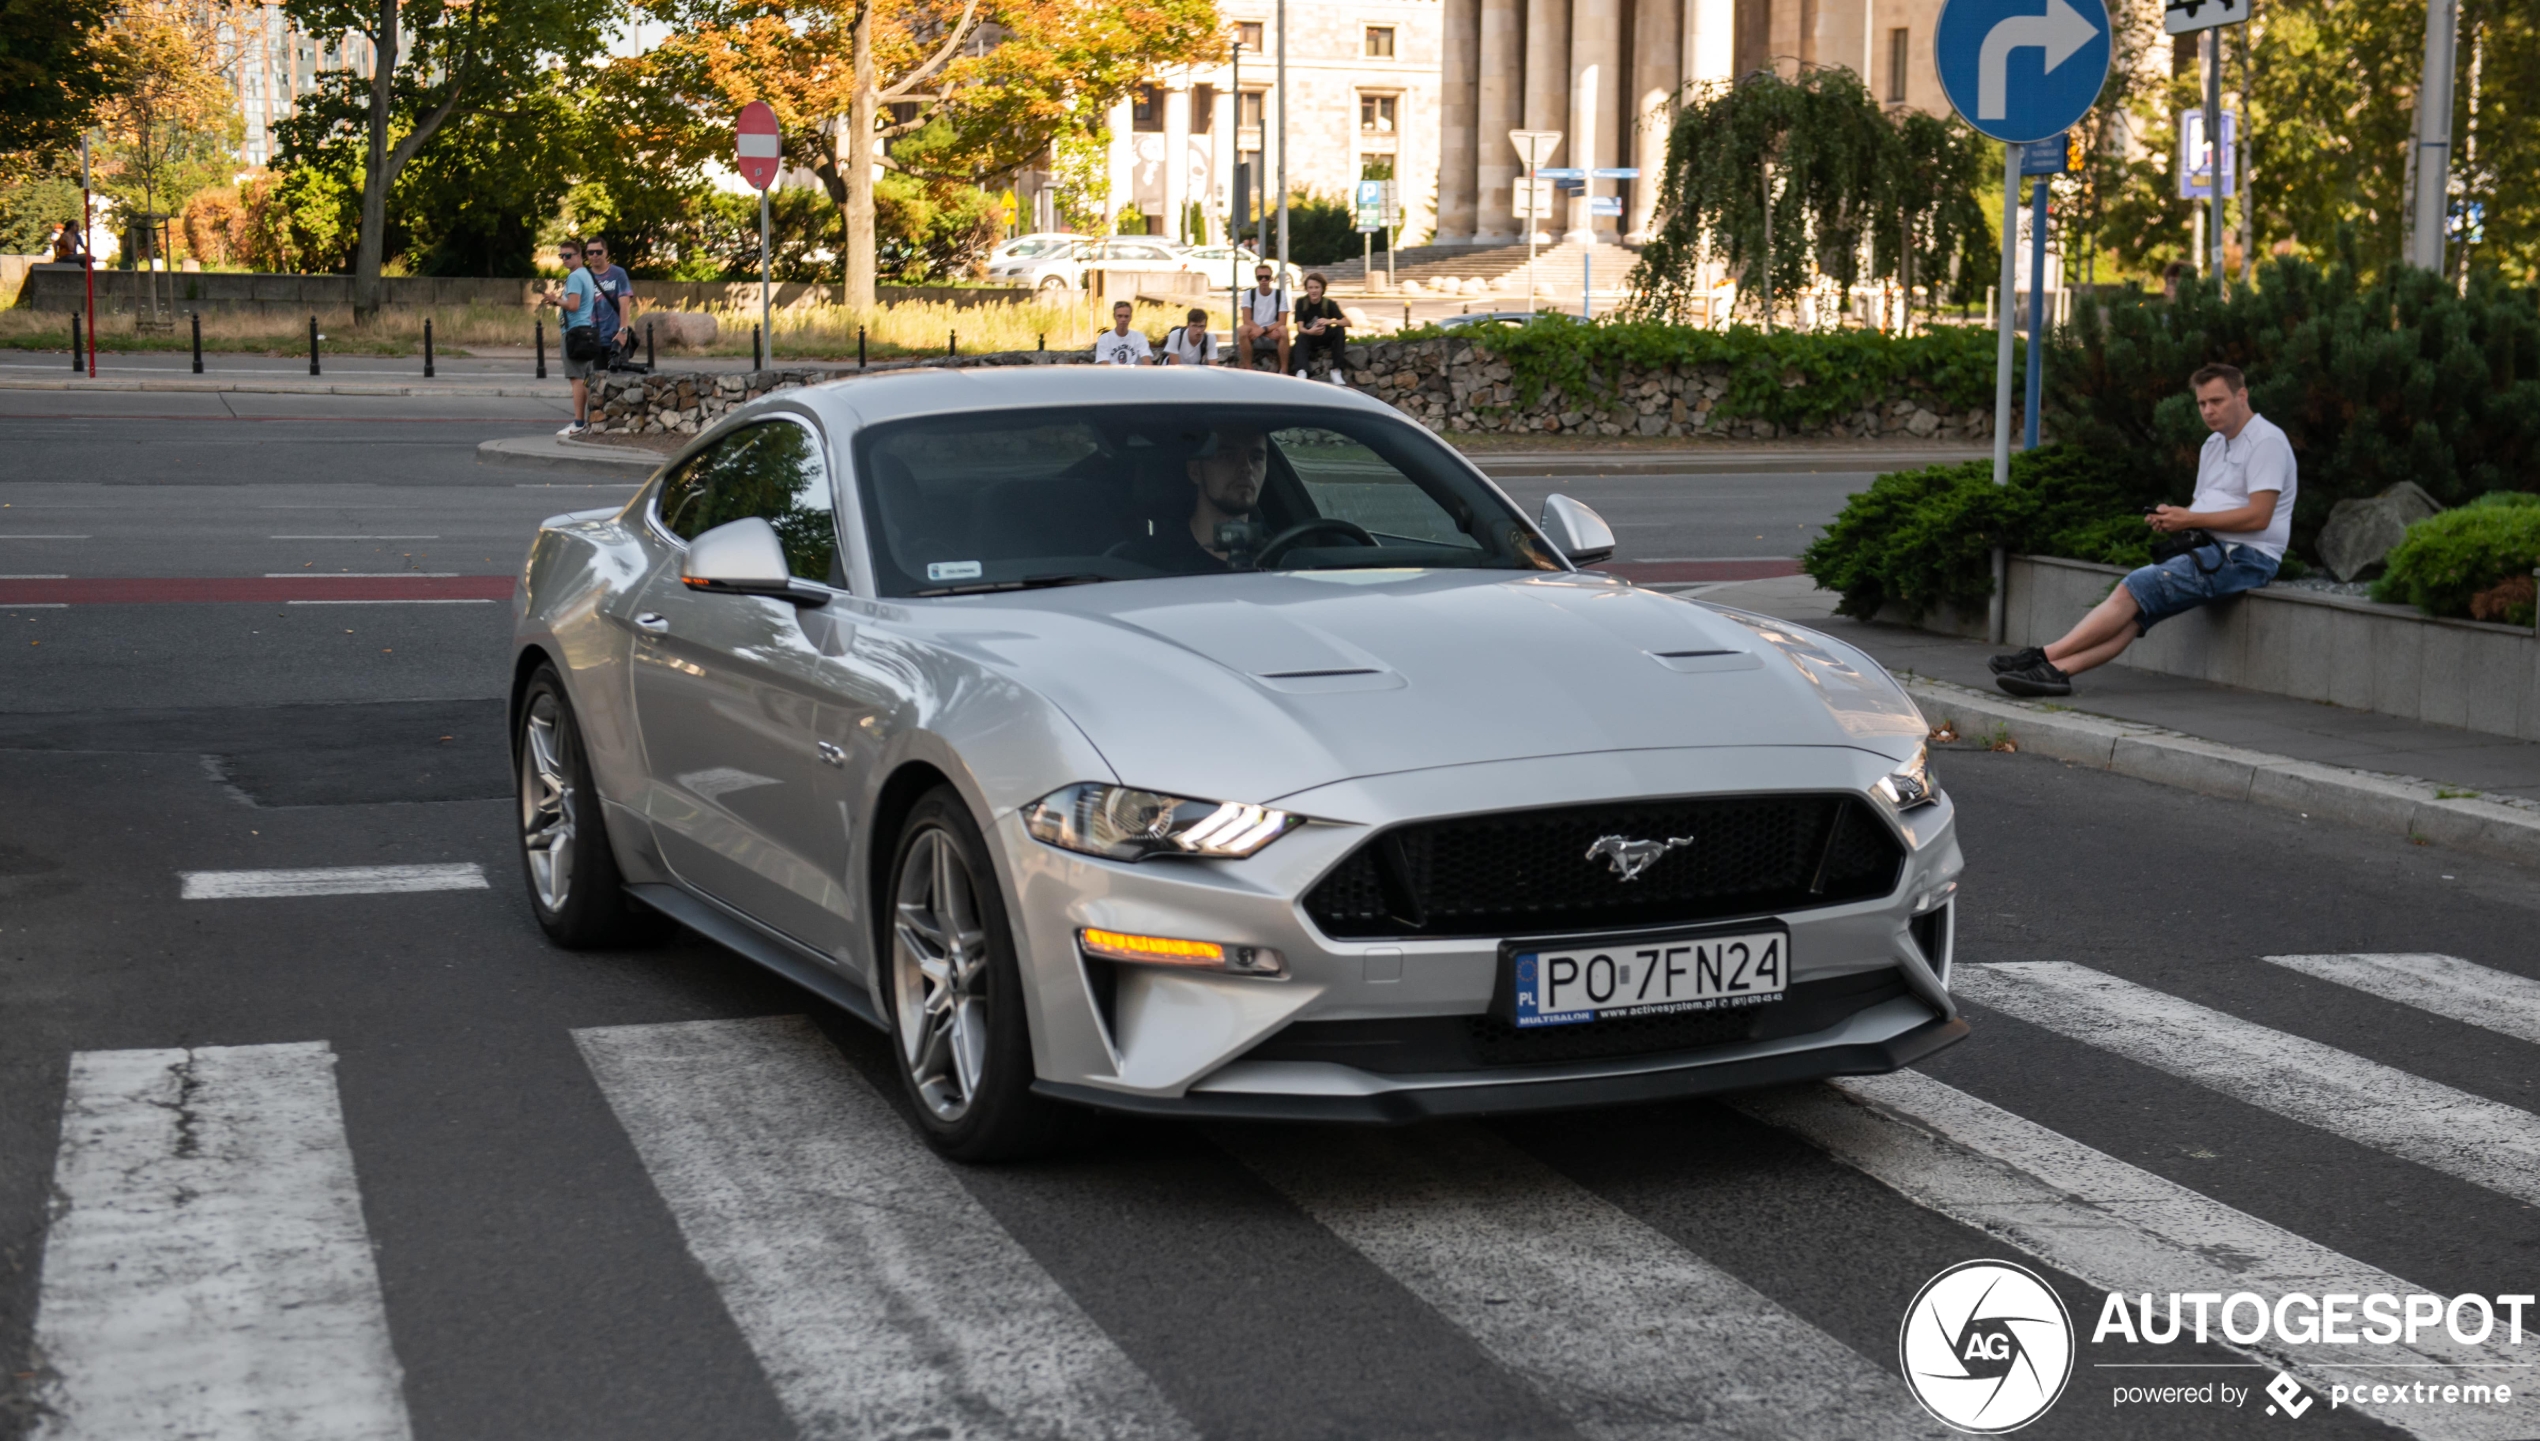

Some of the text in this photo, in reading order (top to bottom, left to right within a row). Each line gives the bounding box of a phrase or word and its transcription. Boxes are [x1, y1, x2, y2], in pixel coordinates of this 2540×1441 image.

[1362, 183, 1377, 202] P
[1549, 938, 1779, 1007] PO 7FN24
[1519, 992, 1536, 1006] PL
[1600, 999, 1716, 1018] www.activesystem.pl
[1519, 1012, 1589, 1025] MULTISALON
